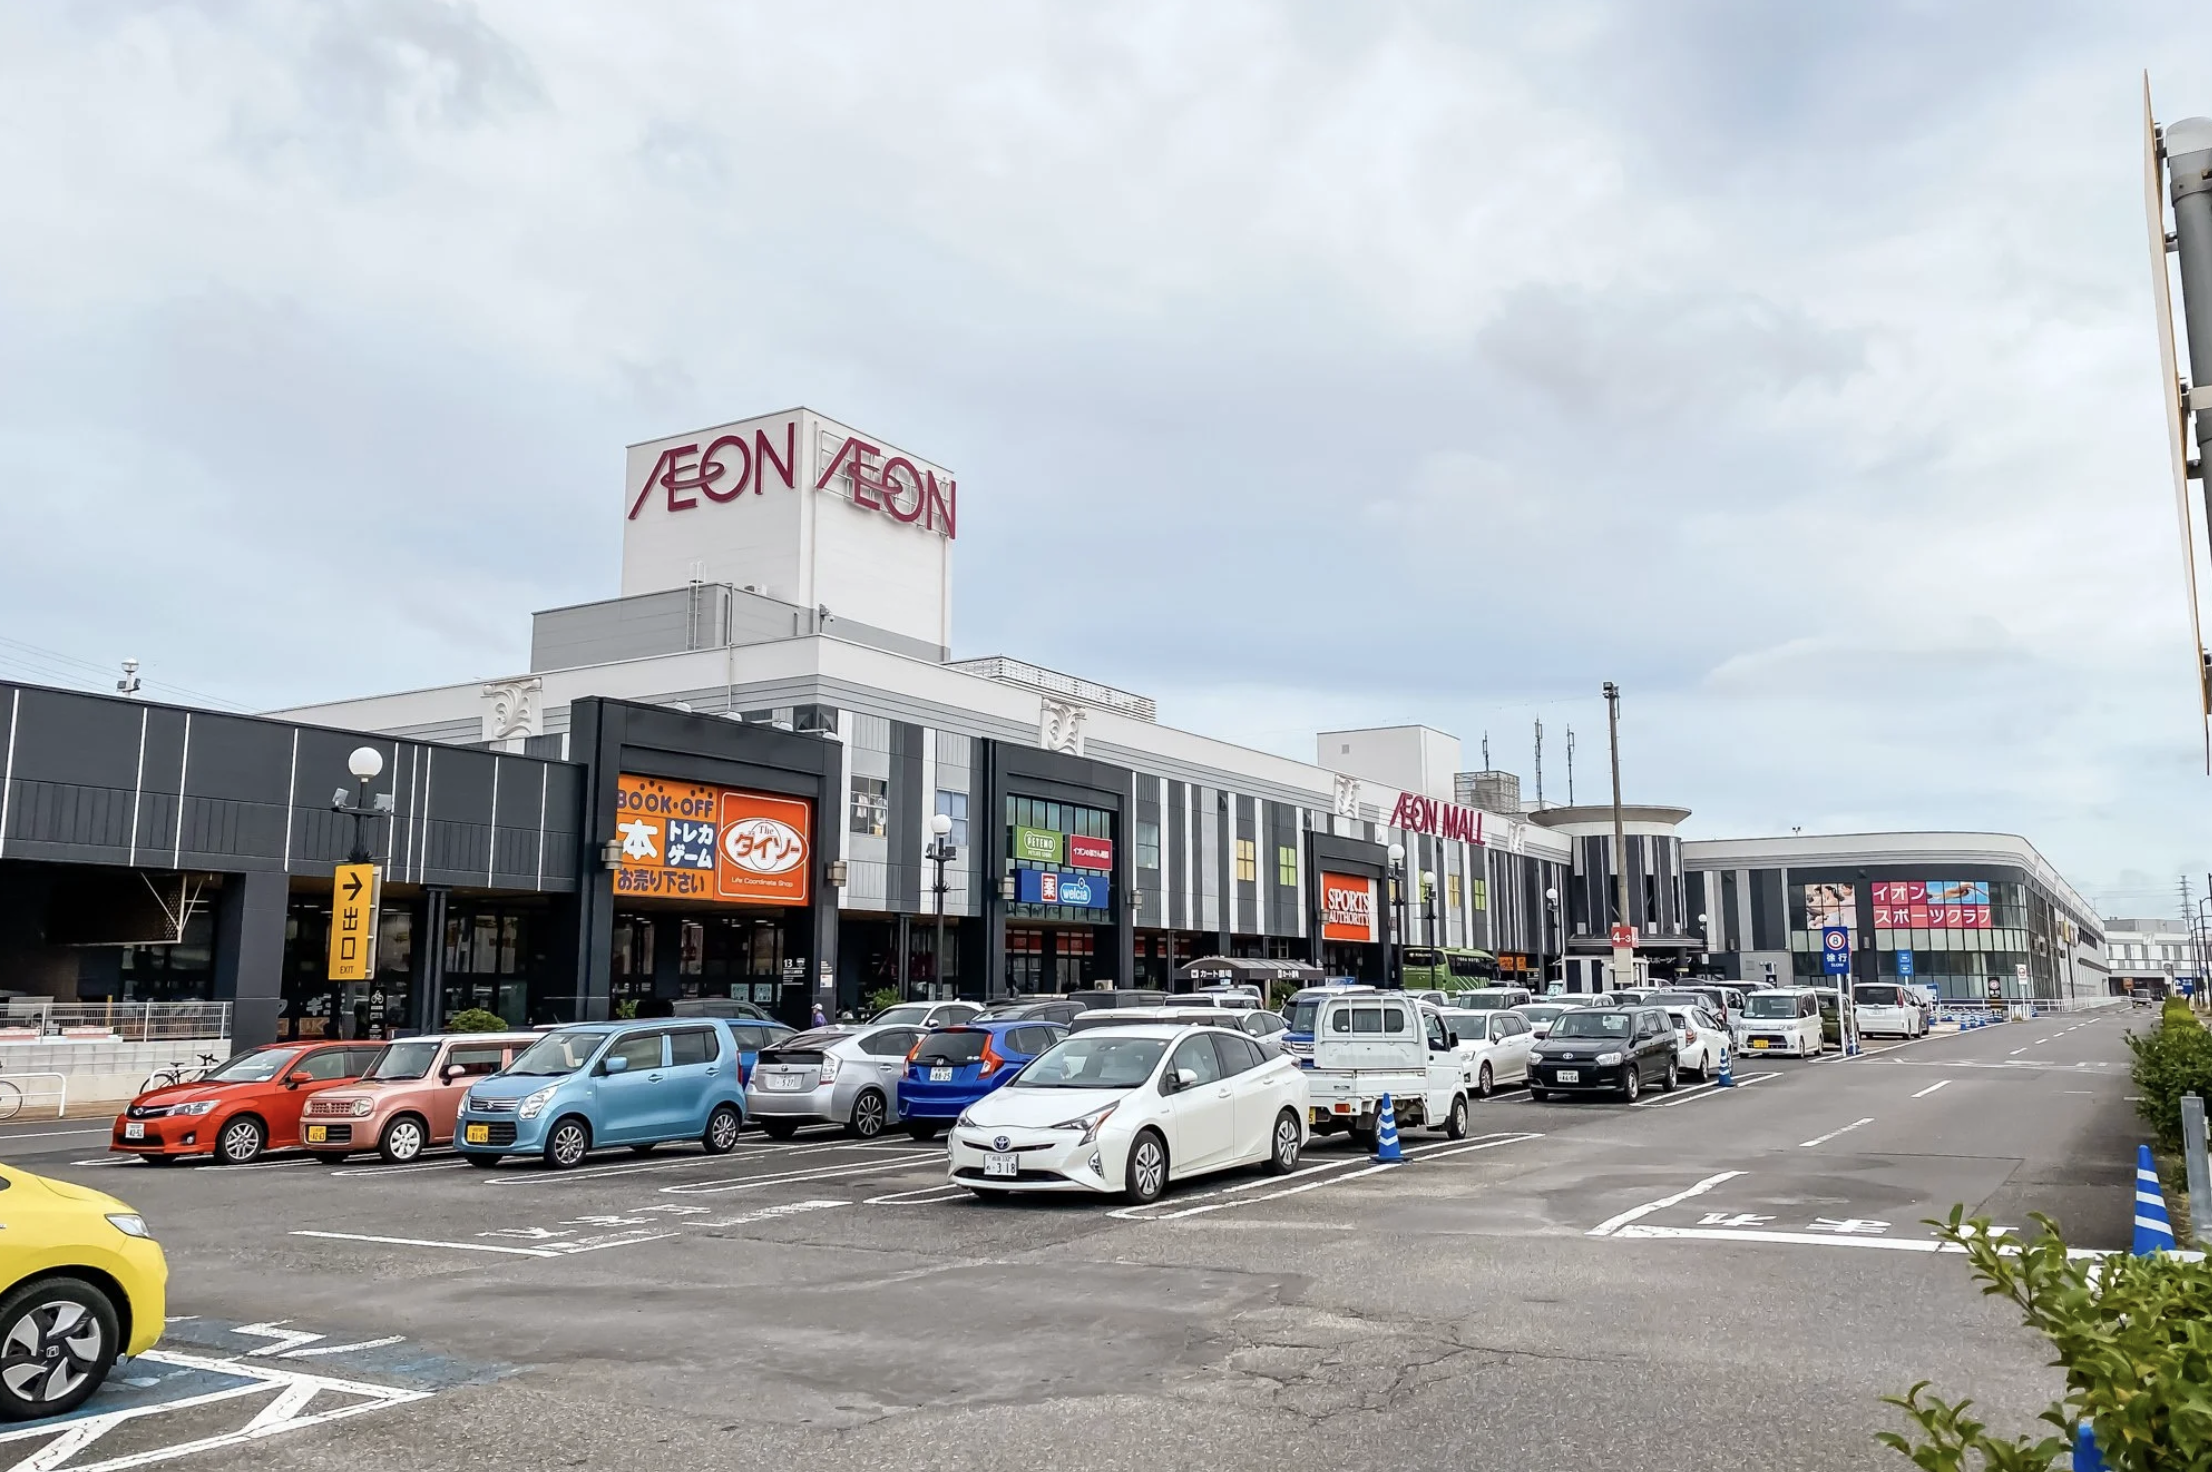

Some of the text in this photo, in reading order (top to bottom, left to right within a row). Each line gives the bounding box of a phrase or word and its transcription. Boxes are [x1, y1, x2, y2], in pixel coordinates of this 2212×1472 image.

[669, 820, 714, 845] トレカ
[758, 825, 774, 836] The
[1443, 804, 1486, 846] MALL
[618, 819, 658, 861] 本
[734, 832, 800, 860] ダイソー
[667, 843, 713, 870] ゲーム
[617, 867, 705, 894] お売り下さい
[731, 876, 743, 885] Life
[1328, 888, 1370, 913] SPORTS
[1873, 885, 1925, 901] イオン
[1328, 910, 1370, 926] AUTHORITY
[1874, 907, 1991, 925] スポーツクラブ
[340, 906, 358, 960] 出口
[1612, 931, 1632, 943] 4-3
[339, 965, 354, 975] EXIT
[784, 958, 793, 968] 13
